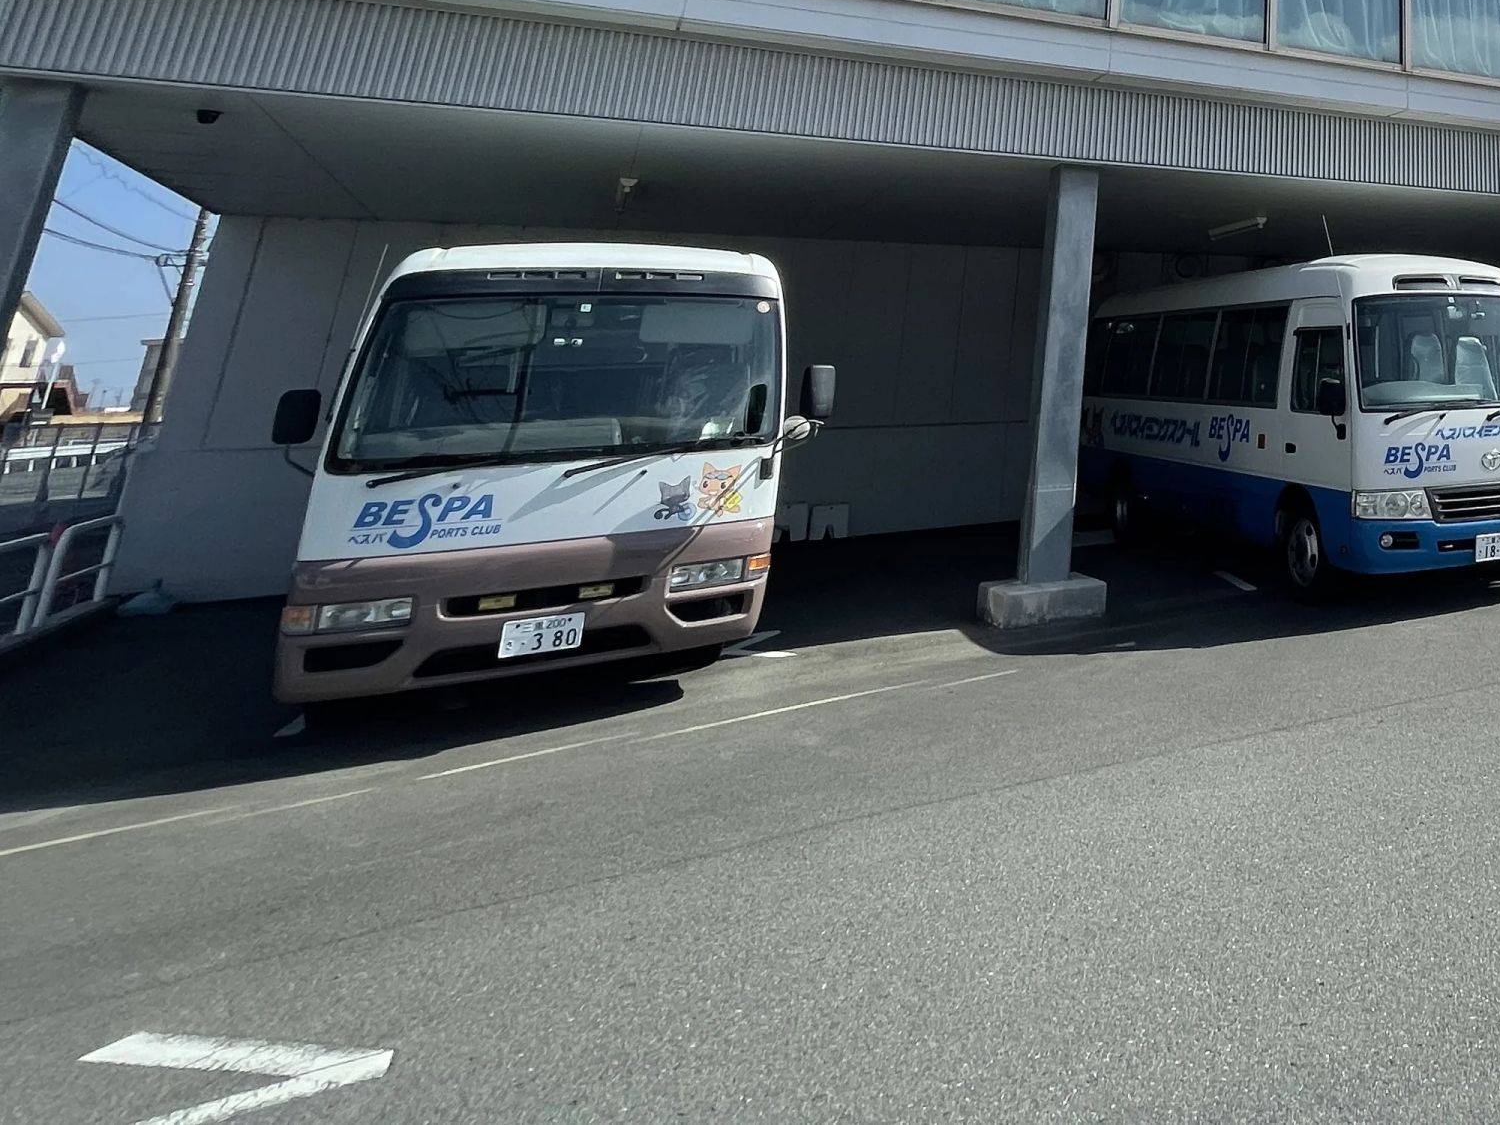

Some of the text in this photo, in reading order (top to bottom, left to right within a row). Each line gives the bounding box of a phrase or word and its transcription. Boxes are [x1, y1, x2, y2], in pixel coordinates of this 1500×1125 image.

[1208, 414, 1250, 462] BESPA
[1384, 442, 1451, 479] BESPA
[353, 493, 494, 549] BESPA
[470, 525, 501, 535] CLUB
